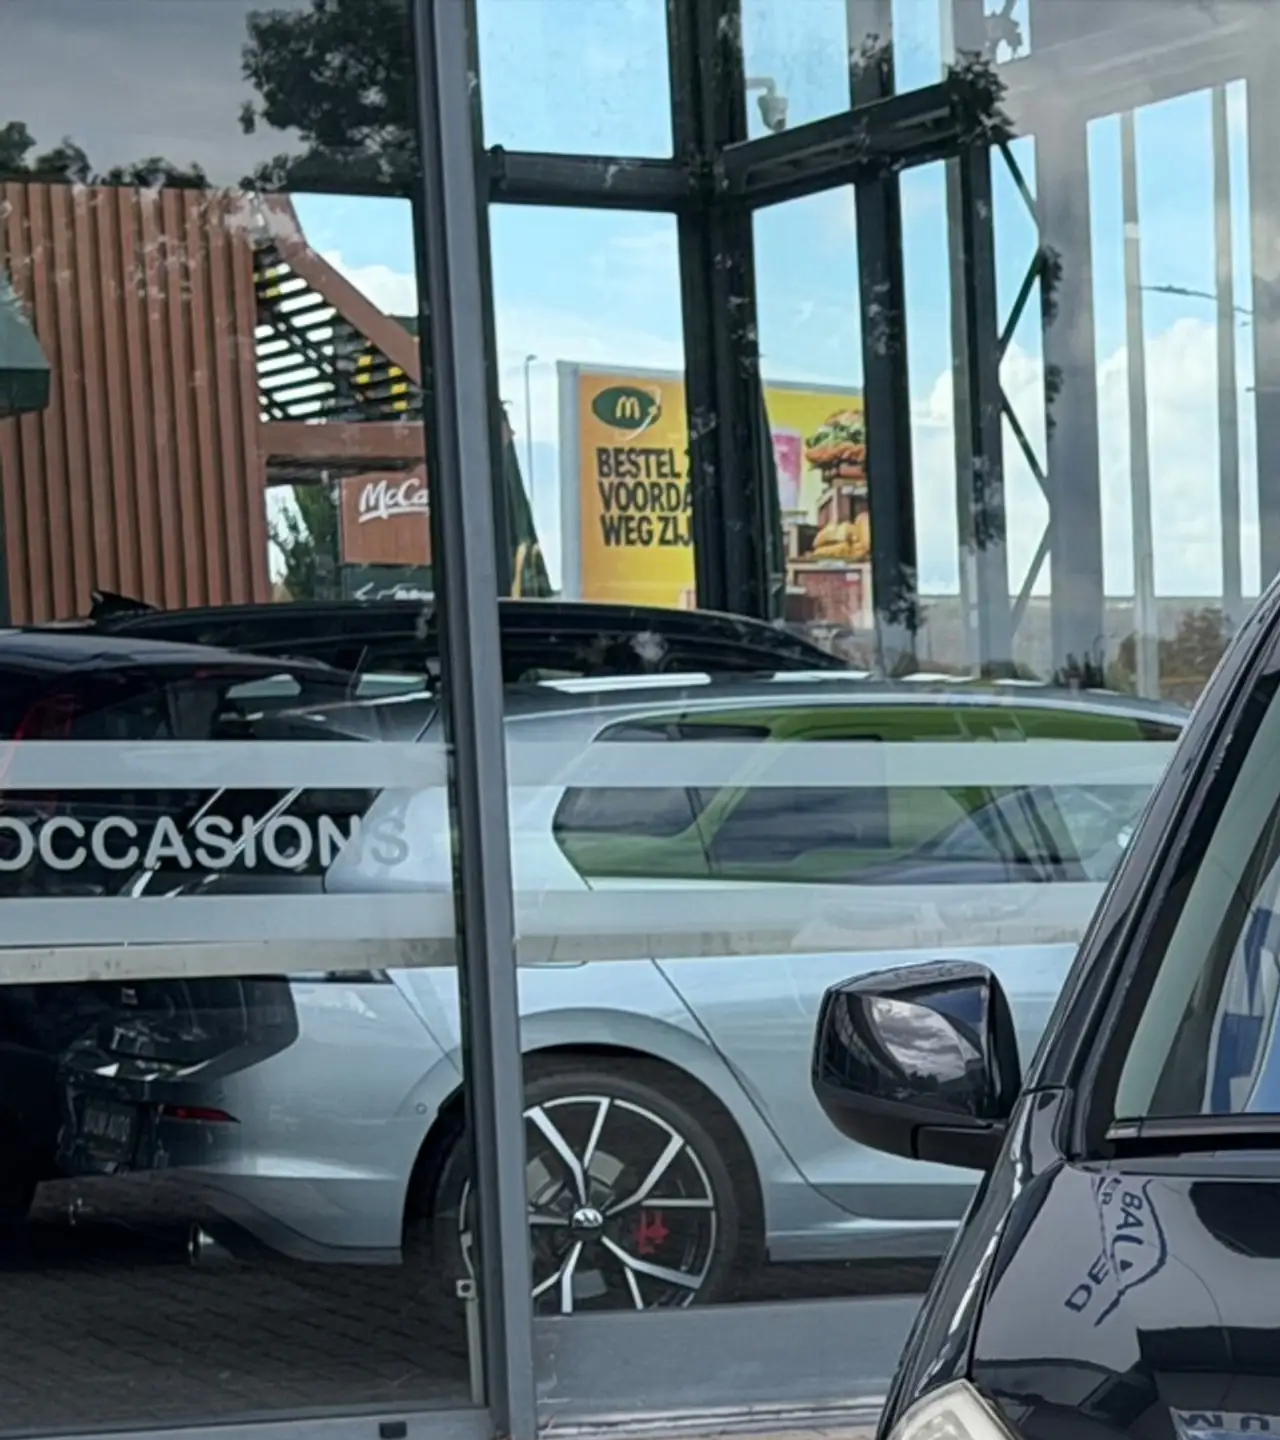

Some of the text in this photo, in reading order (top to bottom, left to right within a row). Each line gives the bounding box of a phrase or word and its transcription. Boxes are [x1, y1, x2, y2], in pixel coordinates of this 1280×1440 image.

[596, 447, 682, 479] BESTEL
[600, 514, 654, 547] WEG
[0, 814, 410, 871] OCCASIONS
